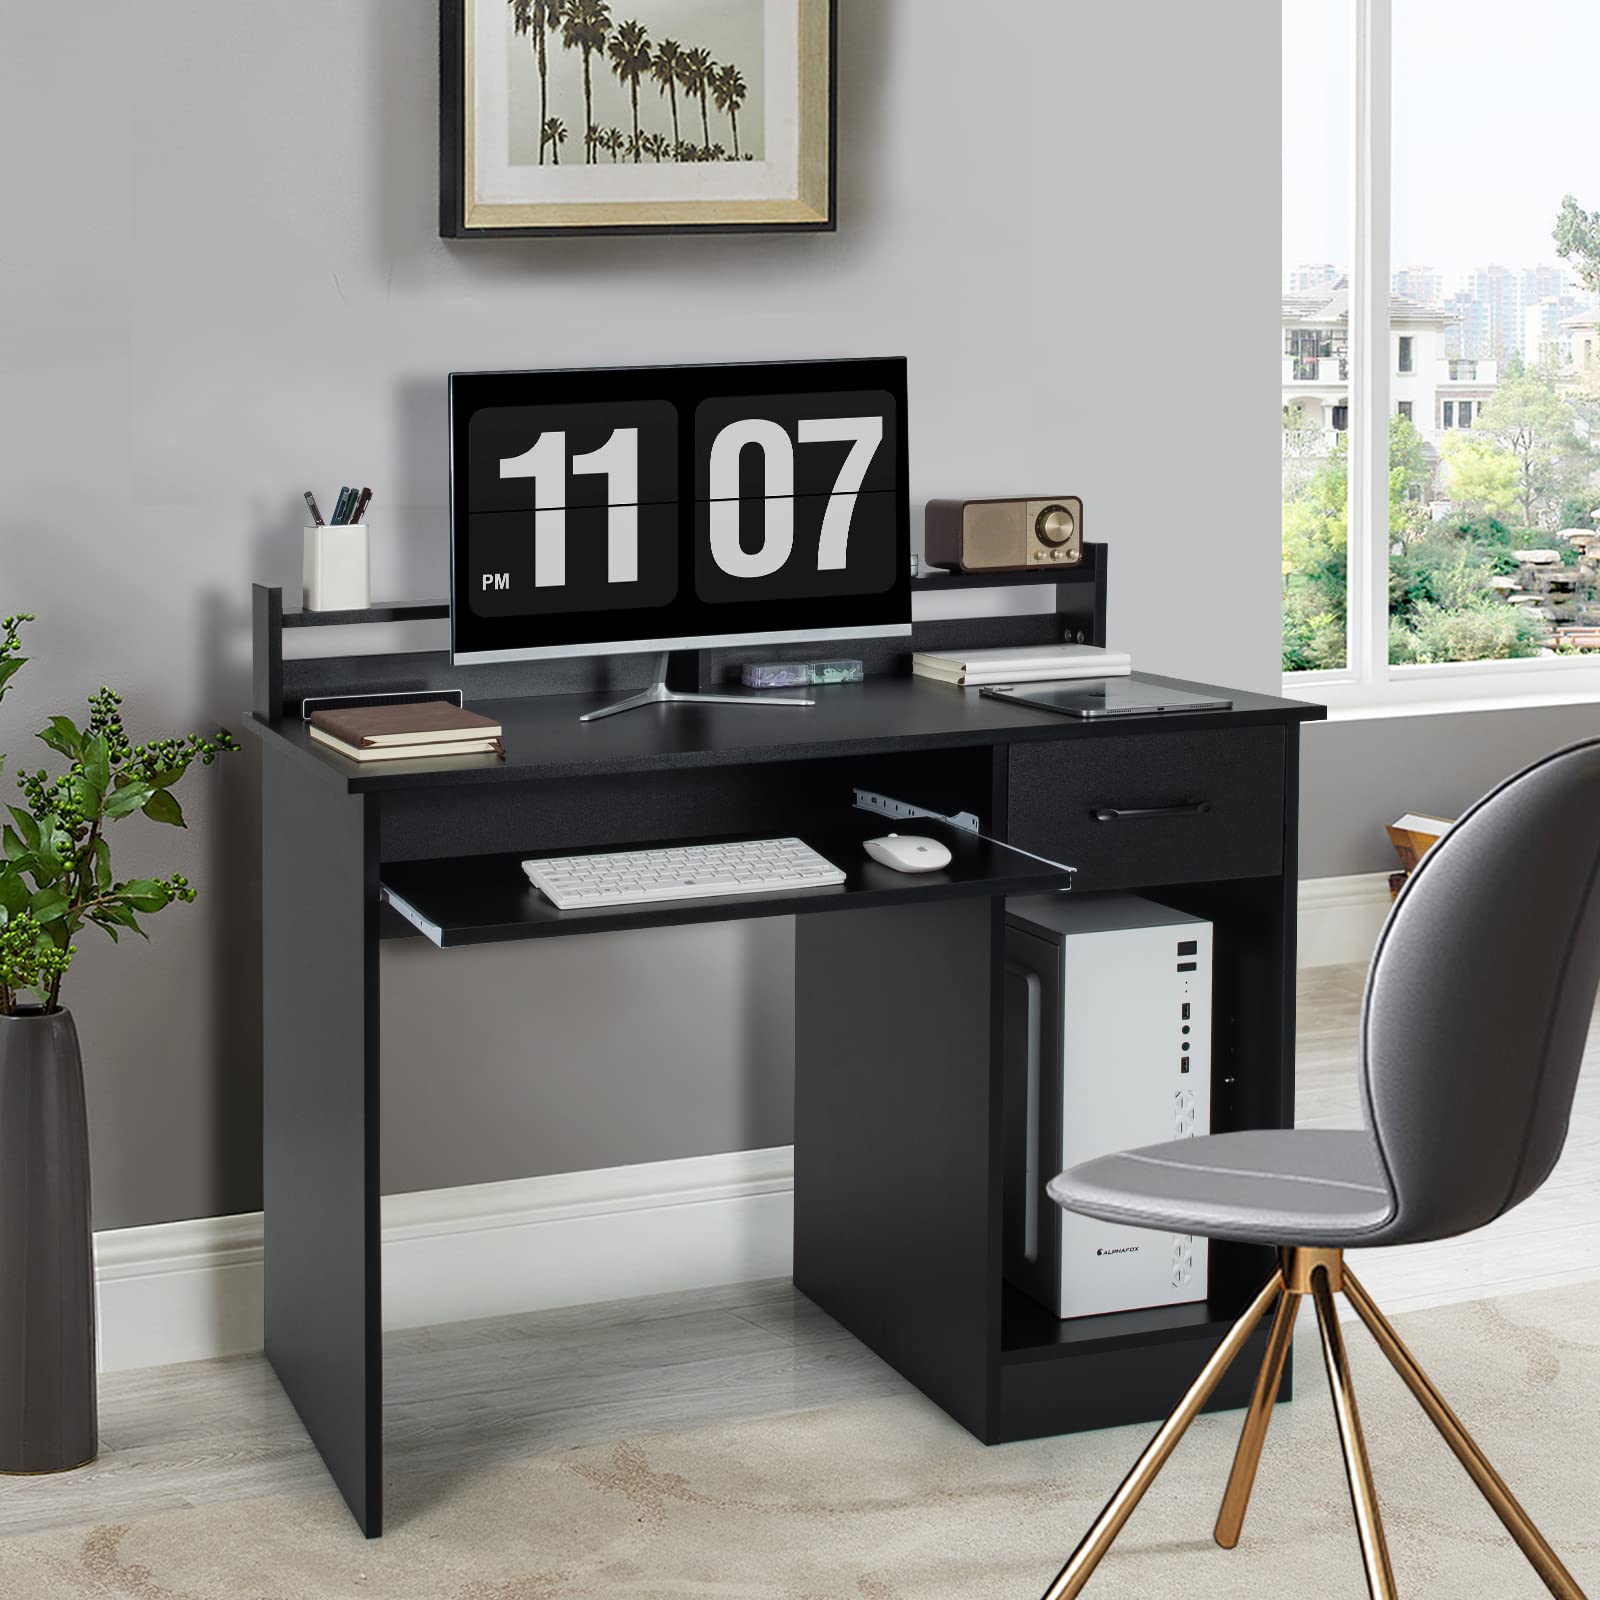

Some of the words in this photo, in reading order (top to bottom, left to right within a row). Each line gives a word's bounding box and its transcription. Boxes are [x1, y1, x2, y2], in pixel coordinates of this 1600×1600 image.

[499, 427, 638, 588] 11
[709, 415, 884, 578] 07
[482, 572, 510, 591] PM
